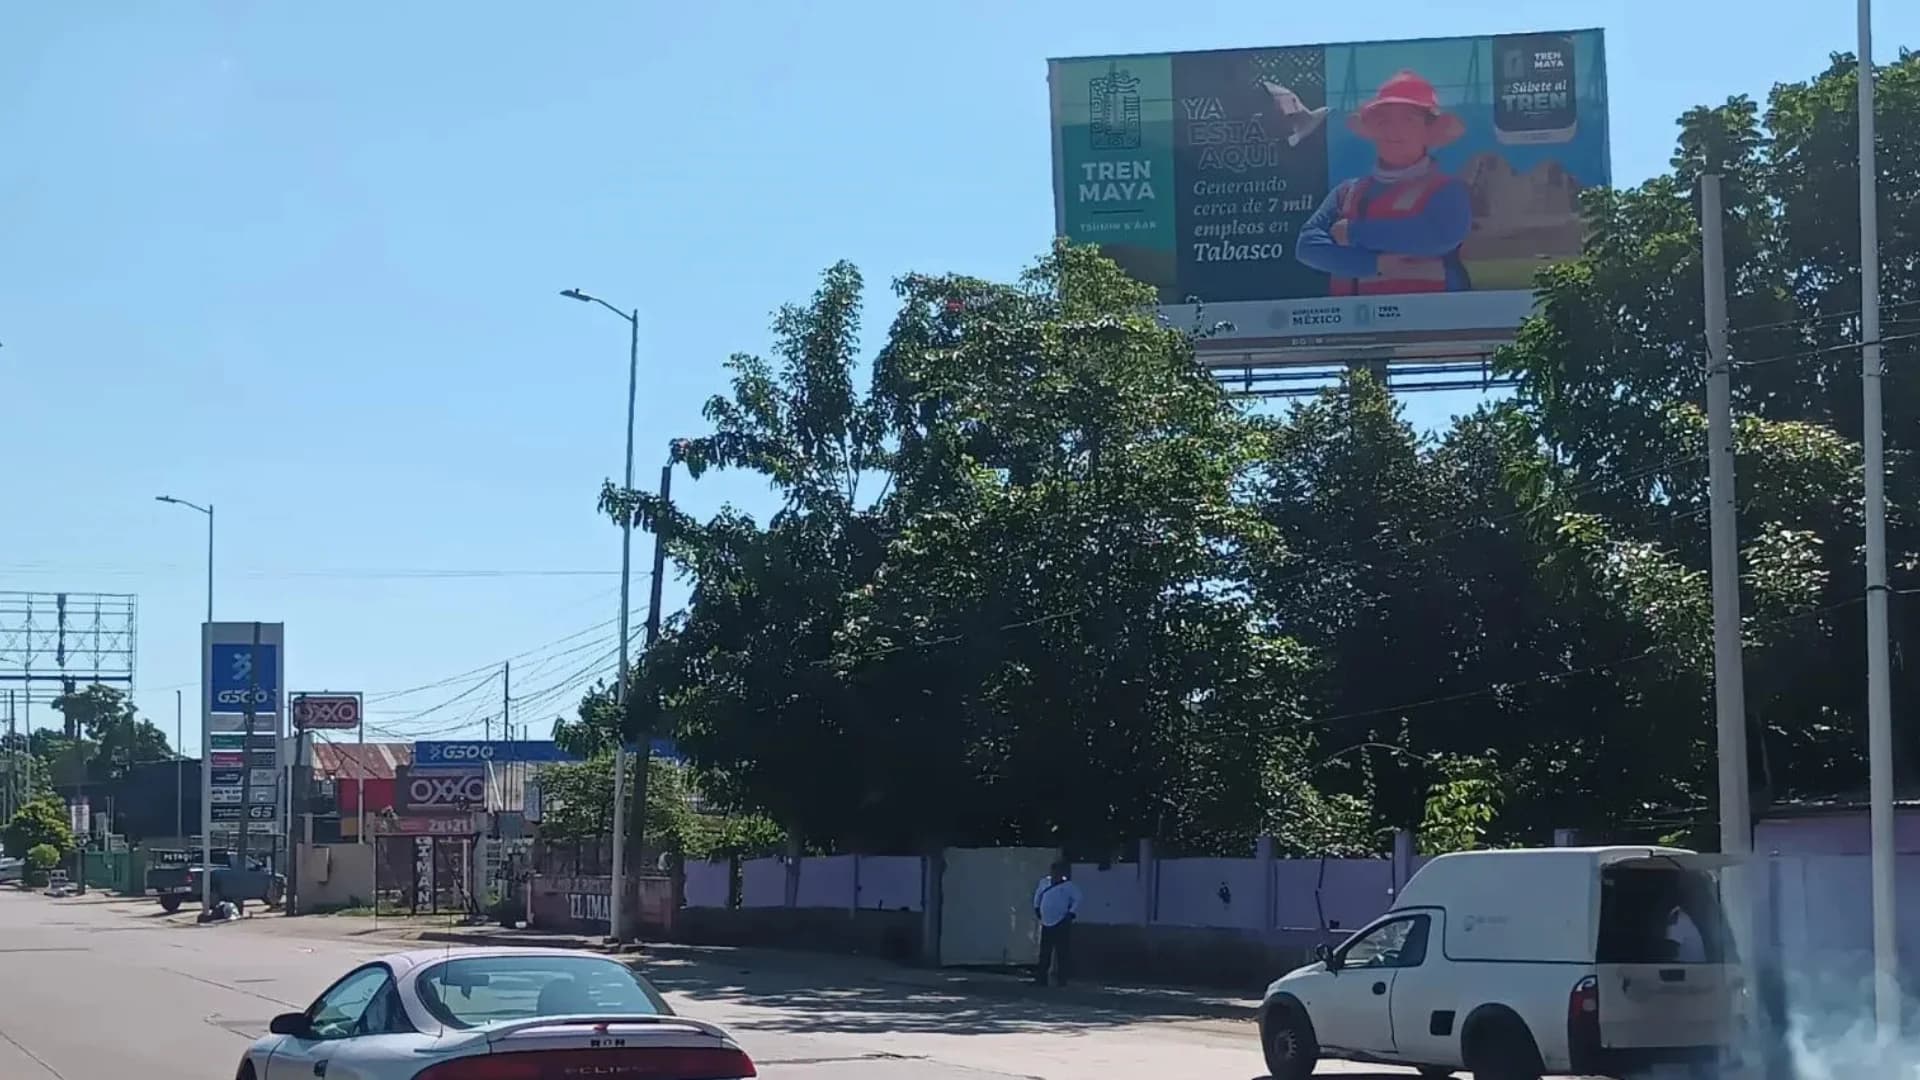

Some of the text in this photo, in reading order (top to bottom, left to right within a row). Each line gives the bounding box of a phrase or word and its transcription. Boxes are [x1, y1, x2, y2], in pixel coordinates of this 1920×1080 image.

[1534, 60, 1564, 69] MAYA
[1555, 80, 1567, 91] al
[1182, 97, 1225, 120] YA
[1502, 92, 1568, 112] TREN
[1081, 161, 1151, 181] TREN
[1079, 182, 1155, 202] MAYA
[1193, 176, 1287, 195] Generando
[1194, 194, 1313, 216] cerca de 7 mil
[1194, 219, 1289, 240] empleos en
[1193, 240, 1283, 261] Tabasco
[296, 702, 354, 726] OXXO
[410, 776, 484, 806] OXXO
[586, 895, 612, 921] IMA
